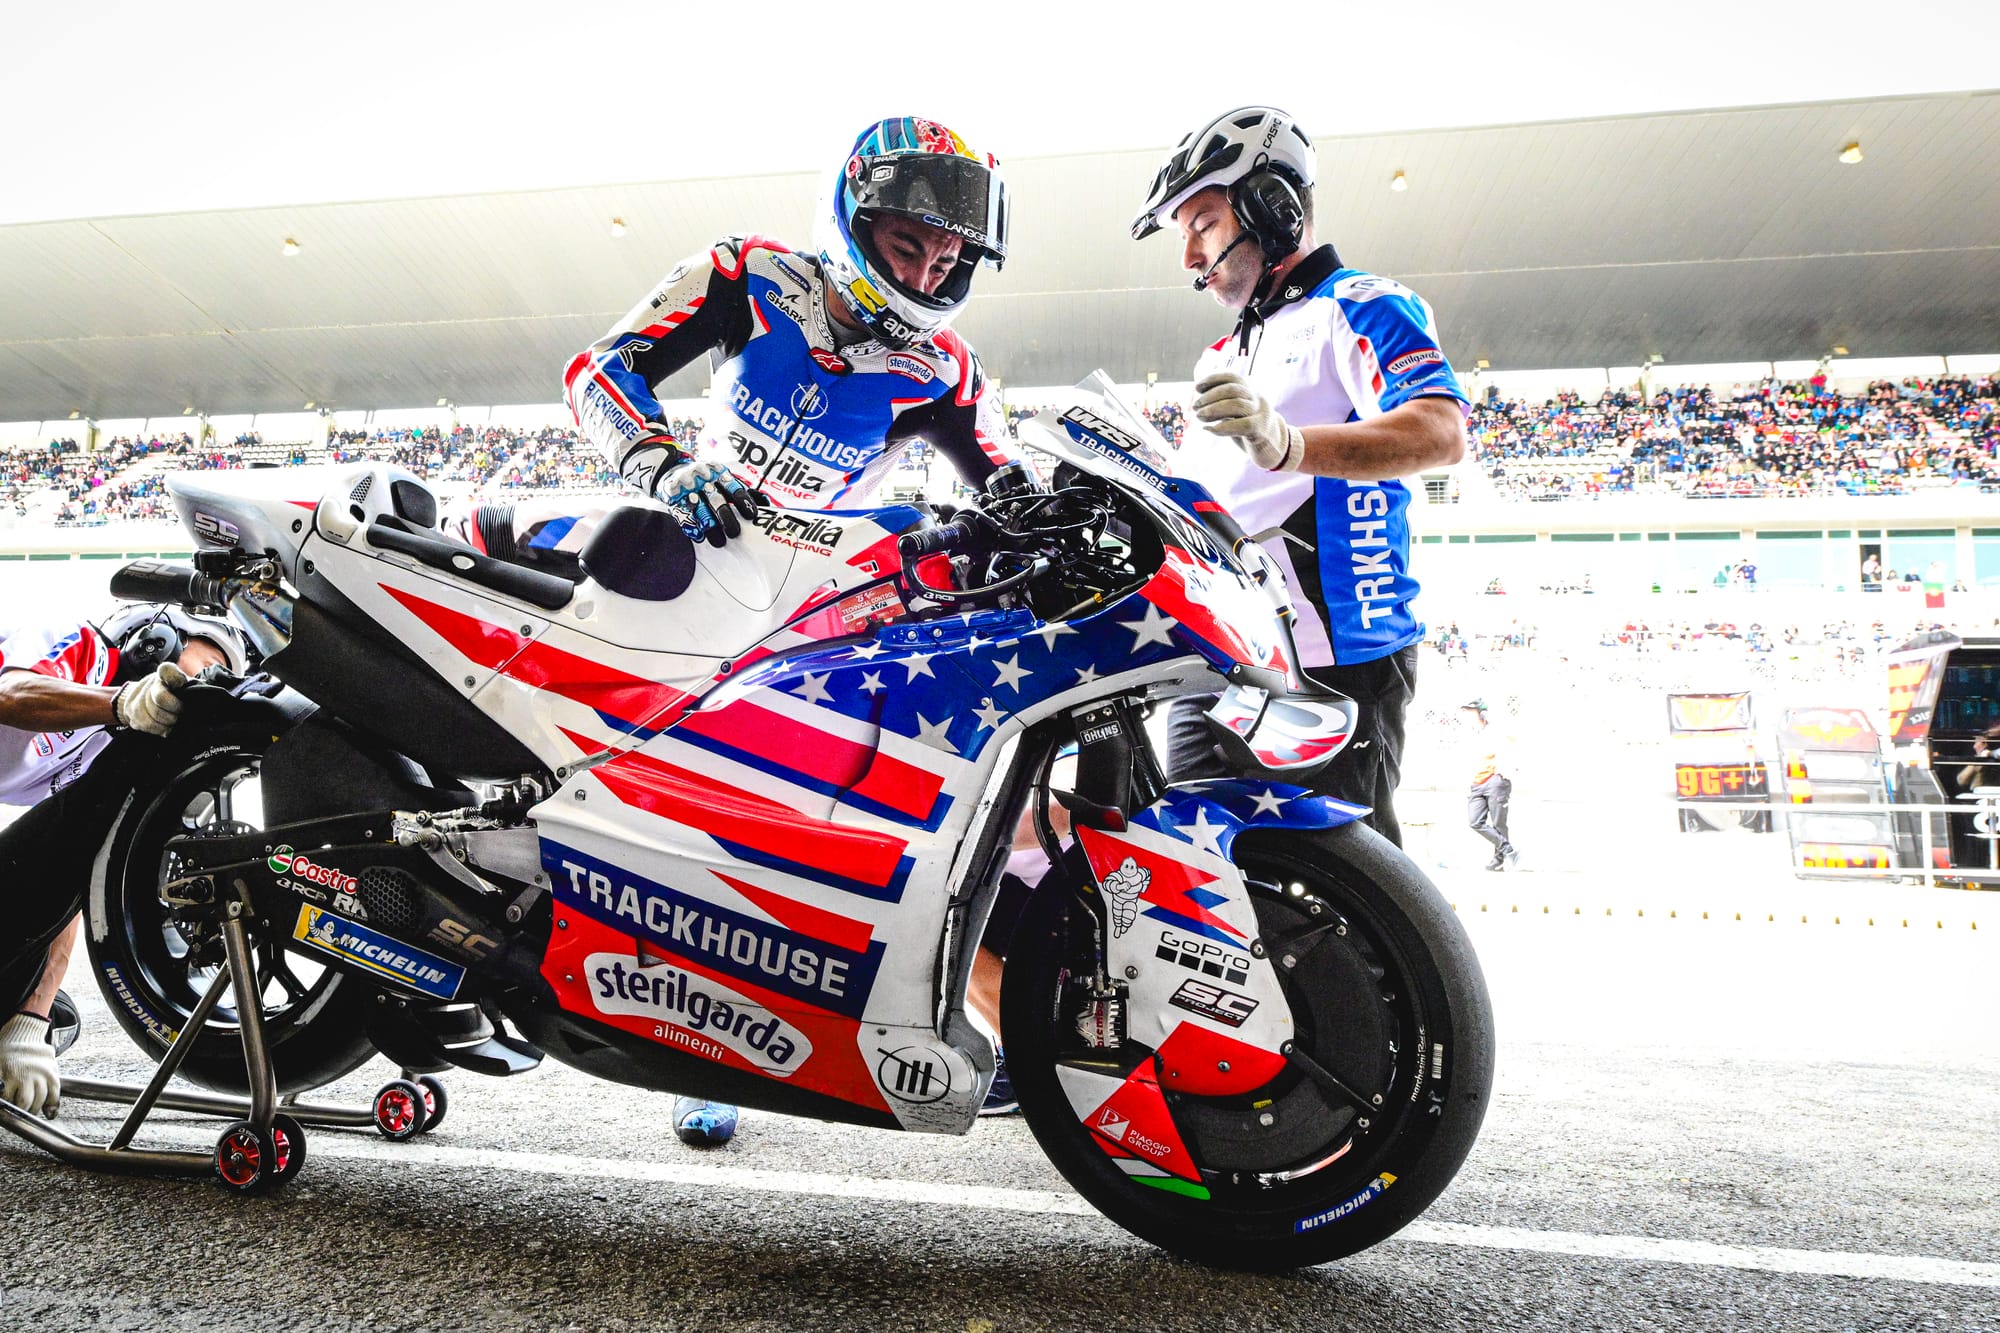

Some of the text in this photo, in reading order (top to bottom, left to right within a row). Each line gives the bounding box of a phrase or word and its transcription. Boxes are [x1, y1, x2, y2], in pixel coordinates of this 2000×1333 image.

[766, 291, 807, 327] SHARK
[889, 357, 931, 380] sterilgarda
[1391, 350, 1440, 371] sterilgarda
[584, 379, 639, 441] RACKHOUSE
[1065, 406, 1140, 449] WRS
[728, 431, 827, 493] aprilia
[1079, 432, 1168, 493] TRACKHOUSE
[194, 526, 240, 545] PROJECT
[195, 512, 240, 539] SC
[752, 508, 844, 548] aprilia
[770, 534, 833, 557] RACING
[1347, 479, 1399, 630] TRKHS
[1083, 725, 1120, 743] ÖHLINS
[292, 855, 359, 895] Castro
[431, 918, 499, 958] SC
[562, 860, 850, 998] TRACKHOUSE
[340, 933, 447, 984] MICHELIN
[1161, 930, 1252, 972] GoPro
[105, 966, 152, 1028] MICHELIN
[596, 957, 797, 1066] sterilgarda
[1173, 993, 1246, 1022] PROJECT
[1177, 980, 1258, 1018] SC
[653, 1022, 724, 1061] alimenti
[1410, 1052, 1426, 1102] marchesini
[1126, 1135, 1165, 1157] GROUP
[1129, 1128, 1172, 1154] PIAGGIO
[1301, 1189, 1372, 1231] MICHELIN
